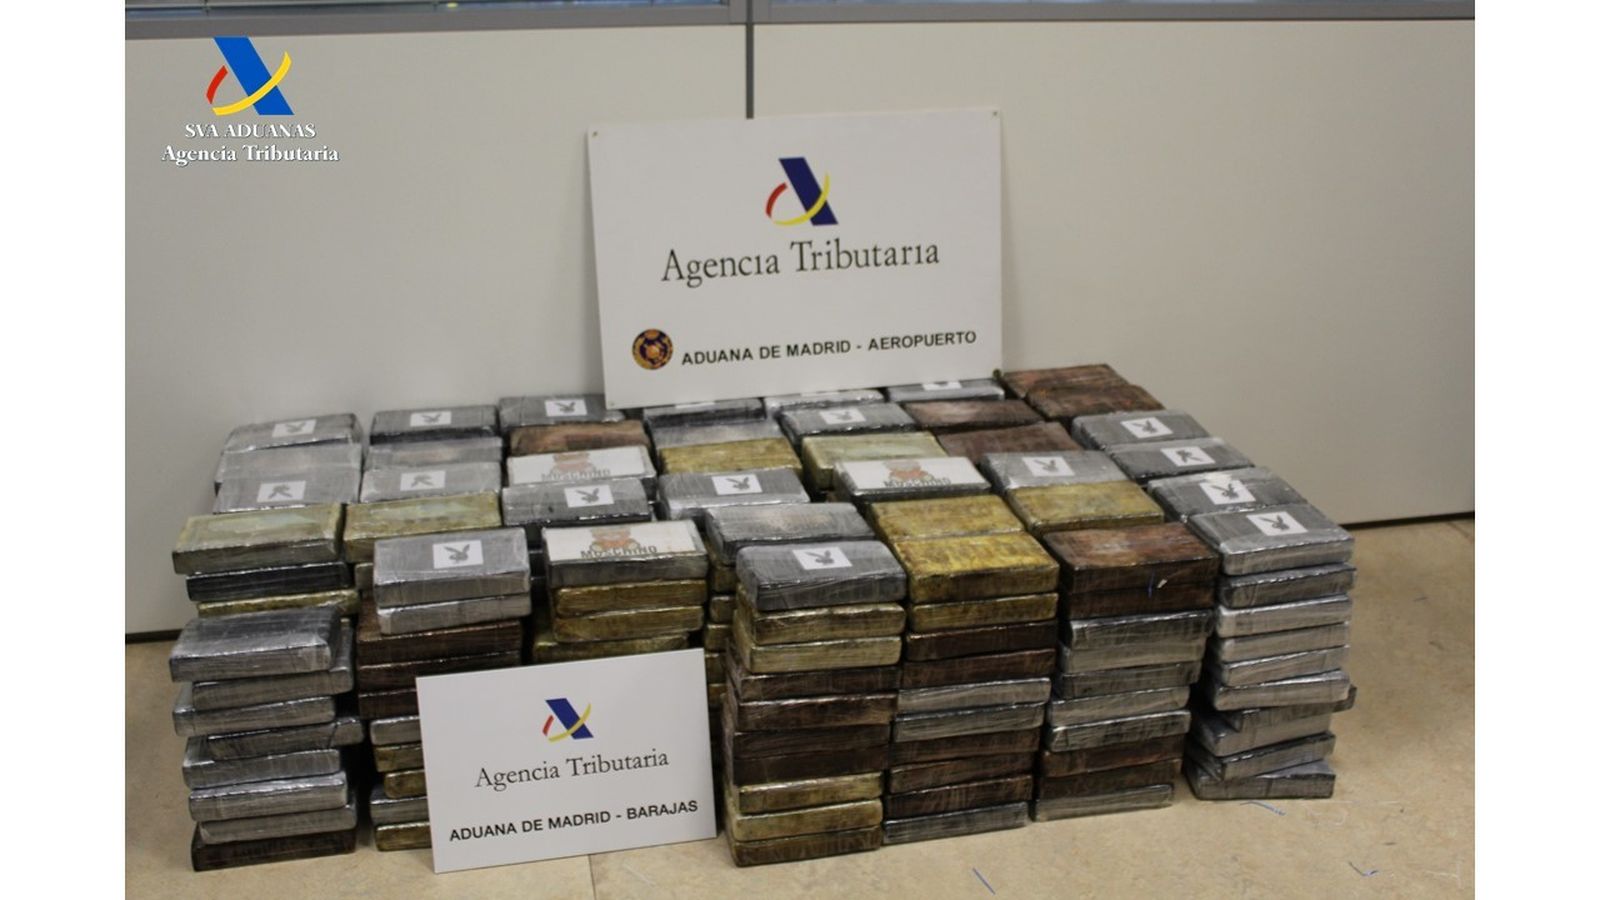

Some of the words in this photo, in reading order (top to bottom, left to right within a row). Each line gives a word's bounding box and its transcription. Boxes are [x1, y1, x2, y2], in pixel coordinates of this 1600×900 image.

[661, 248, 780, 288] Agencia
[790, 238, 940, 272] Tributaria
[681, 347, 753, 366] ADUANA
[759, 345, 781, 360] DE
[786, 340, 851, 358] MADRID
[868, 330, 977, 352] AEROPUERTO
[581, 545, 658, 559] MOSCHINO
[474, 760, 561, 792] Agencia
[566, 748, 669, 777] Tributaria
[449, 822, 518, 842] ADUANA
[522, 818, 544, 833] DE
[548, 810, 612, 829] MADRID
[626, 799, 699, 821] BARAJAS
